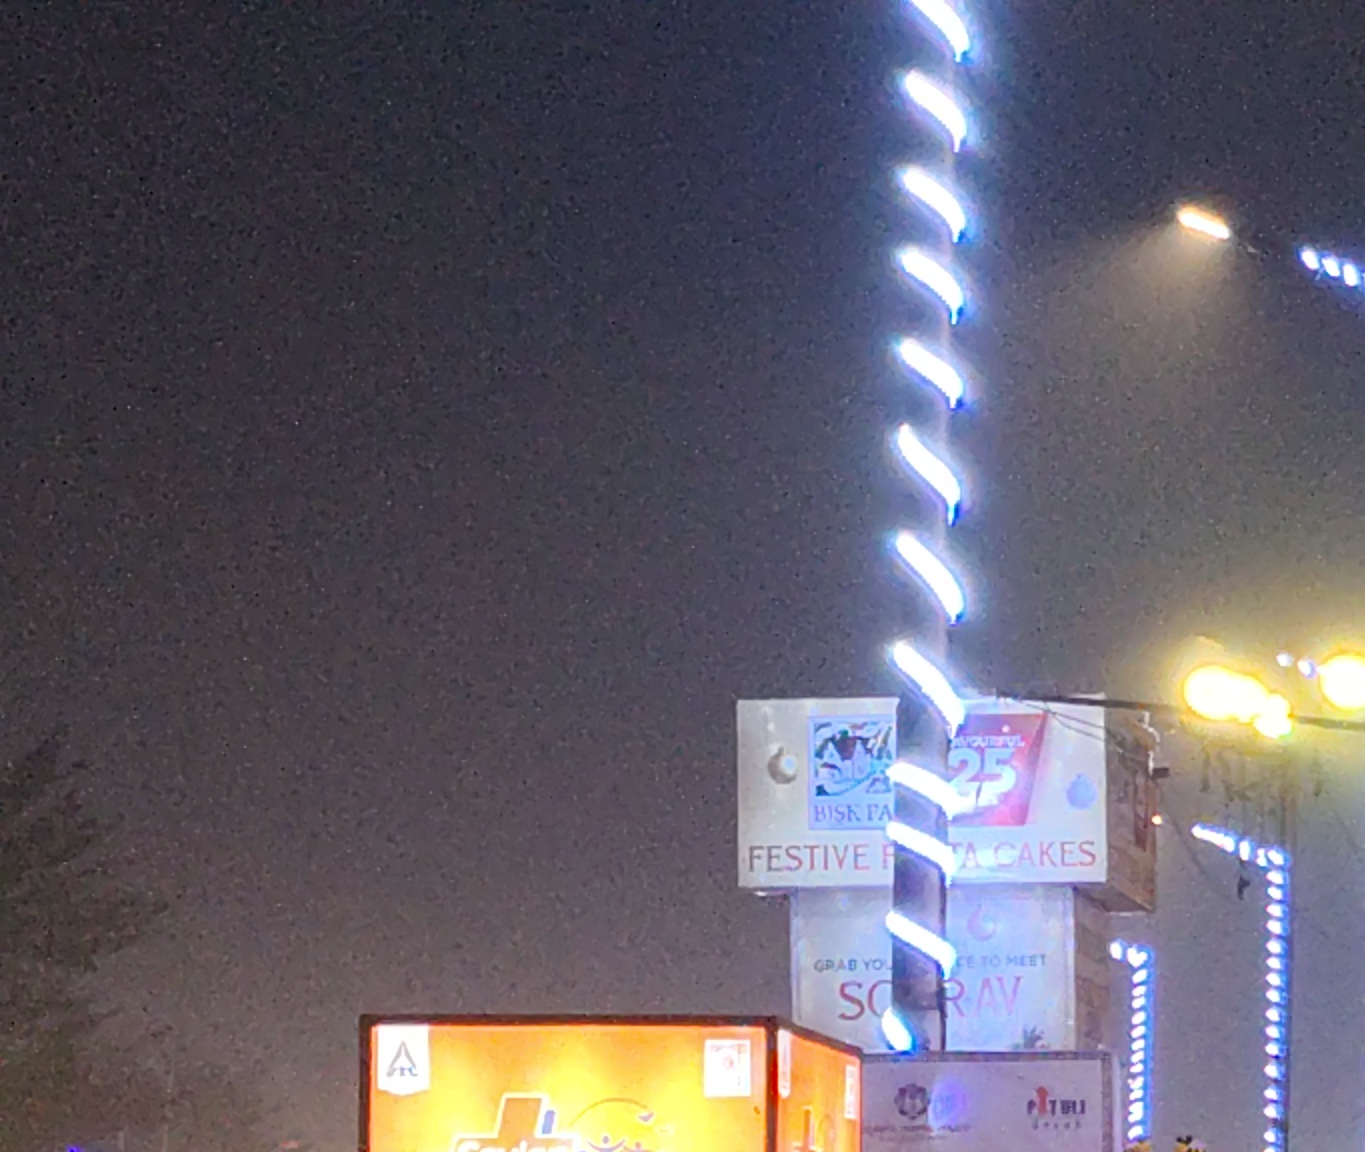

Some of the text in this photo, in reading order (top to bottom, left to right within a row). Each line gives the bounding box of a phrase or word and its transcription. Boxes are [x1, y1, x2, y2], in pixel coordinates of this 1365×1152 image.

[947, 747, 1018, 808] 25
[812, 803, 862, 824] BISK
[748, 843, 872, 873] FESTIVE
[993, 840, 1097, 868] CAKES
[837, 975, 1024, 1021] SORAV
